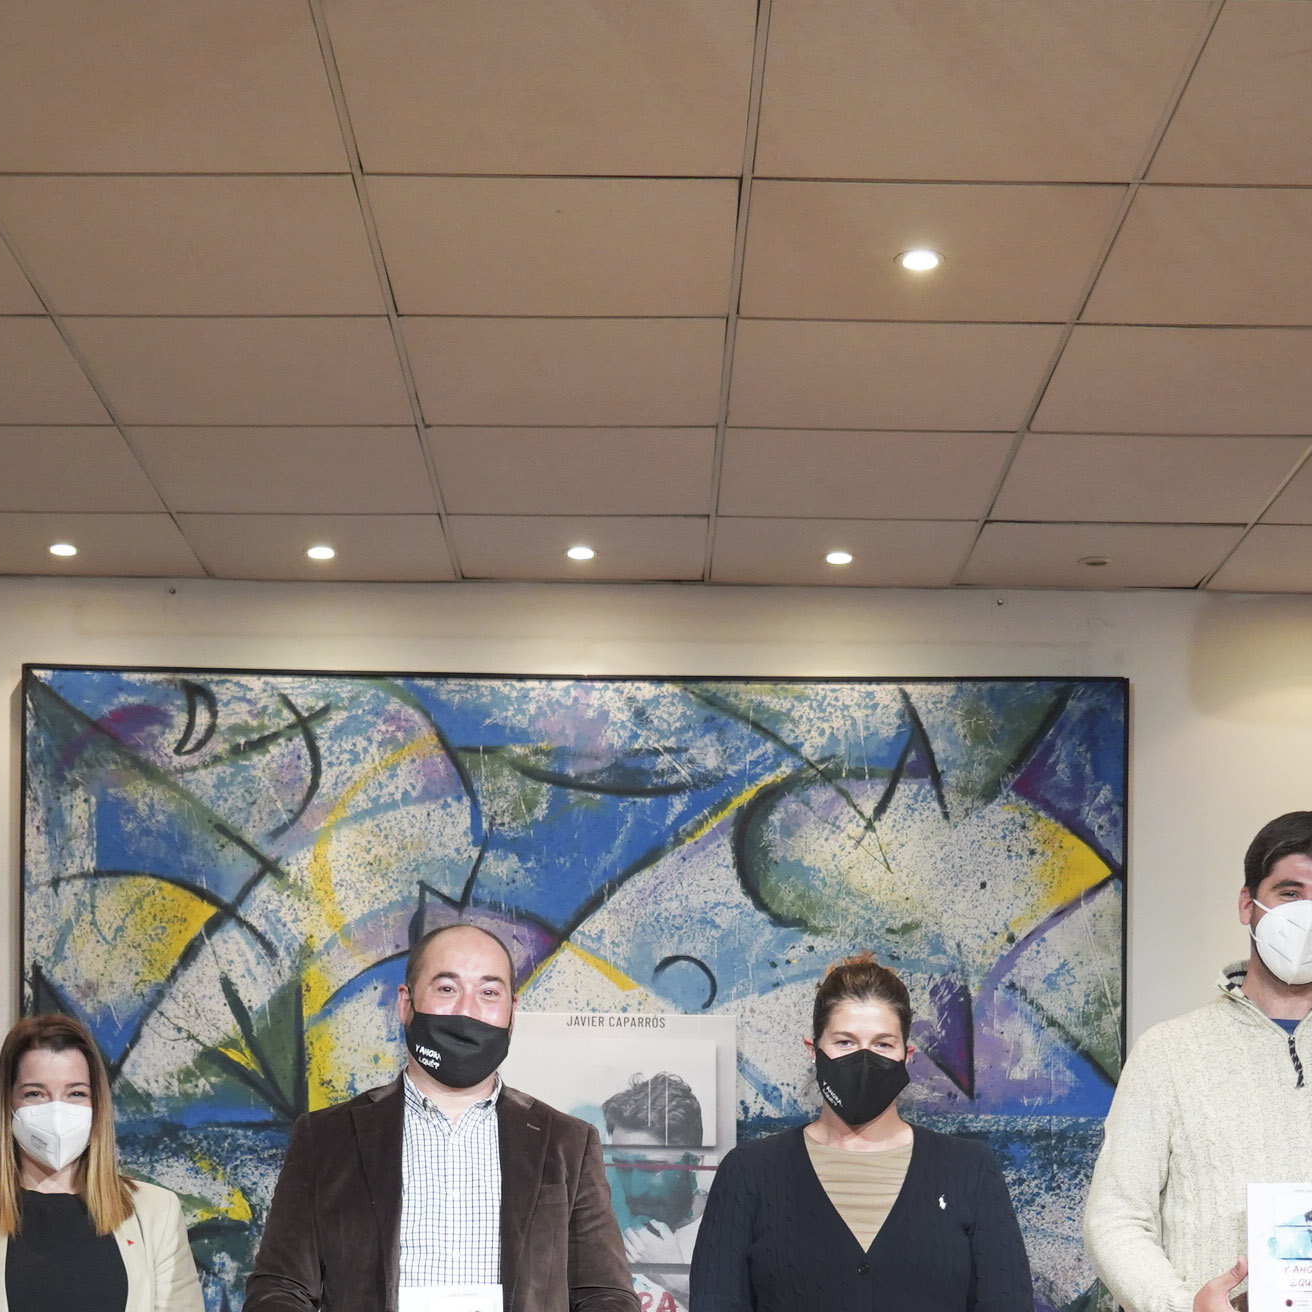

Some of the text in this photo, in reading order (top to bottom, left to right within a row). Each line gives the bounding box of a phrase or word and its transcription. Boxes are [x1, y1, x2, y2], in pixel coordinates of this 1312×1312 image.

[566, 1015, 666, 1028] JAVIER CAPARRÓS
[415, 1044, 420, 1052] Y
[1284, 1266, 1290, 1275] Y
